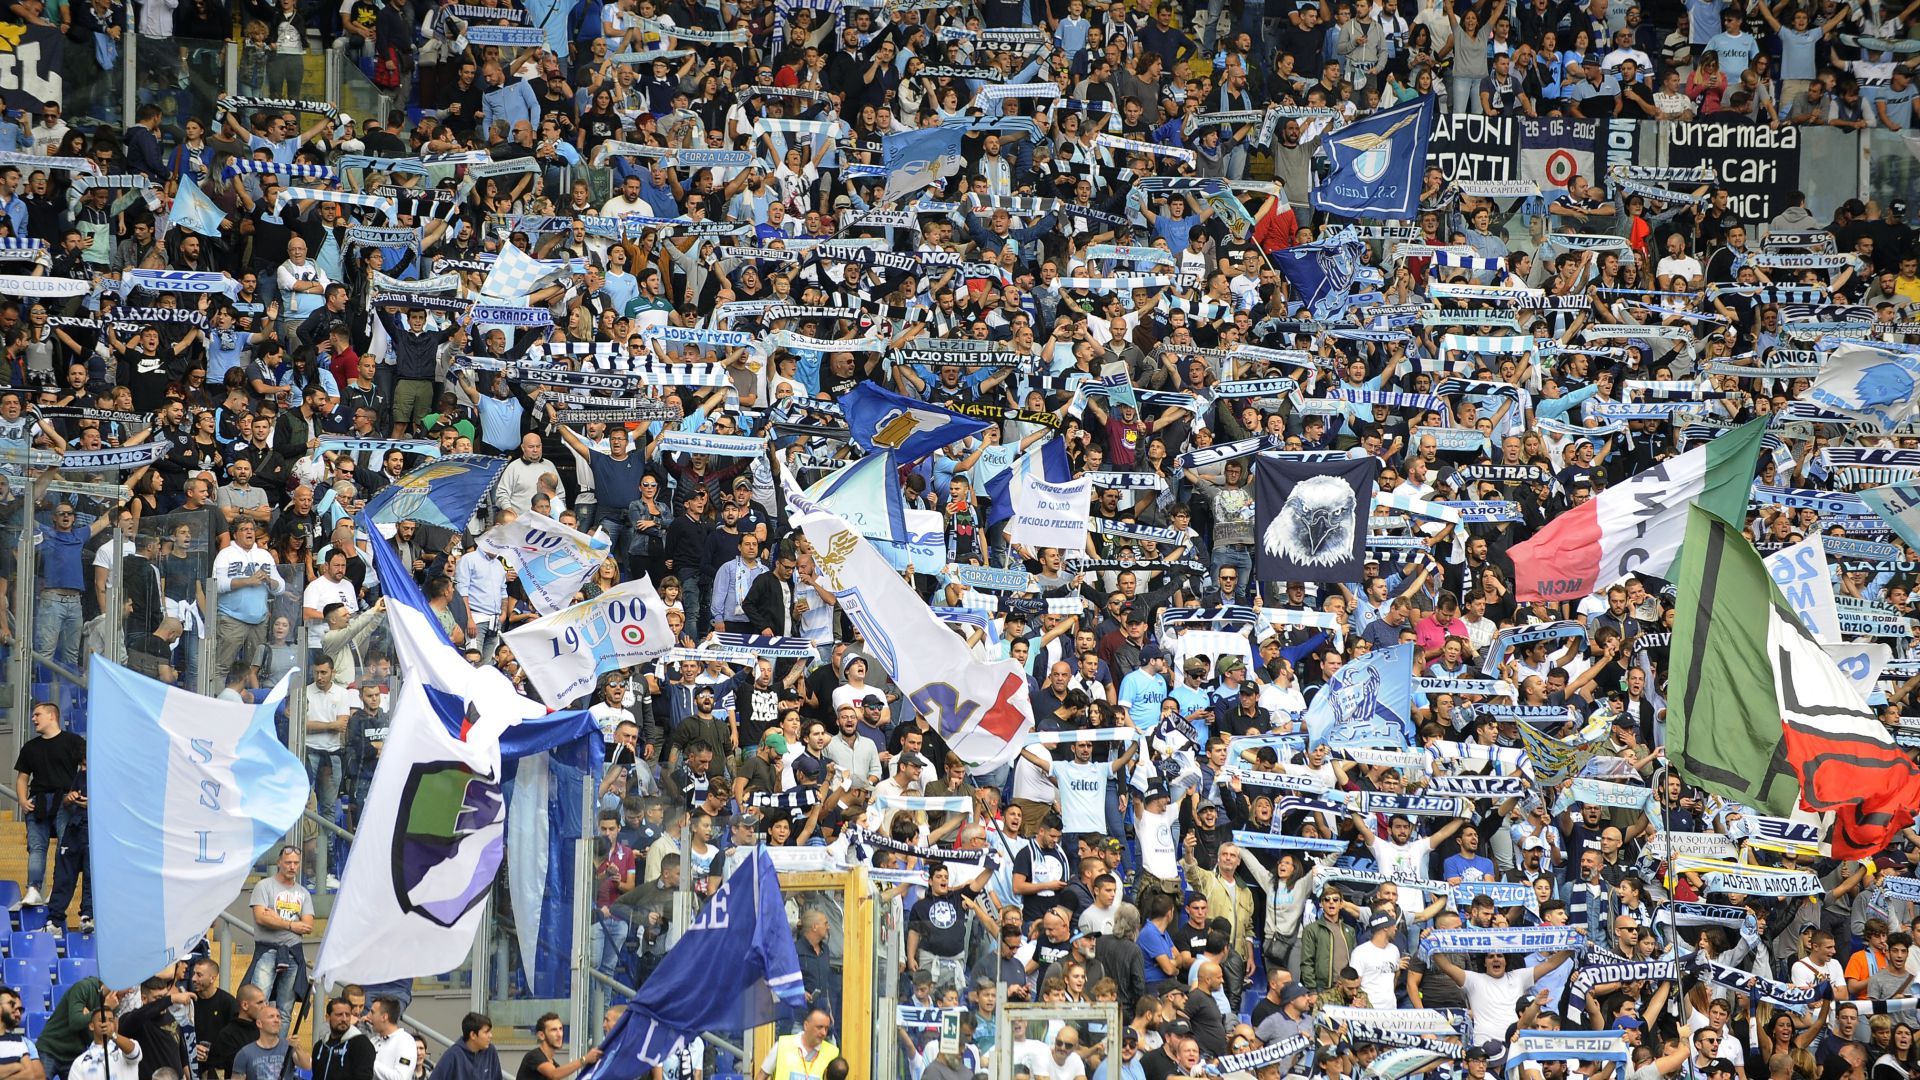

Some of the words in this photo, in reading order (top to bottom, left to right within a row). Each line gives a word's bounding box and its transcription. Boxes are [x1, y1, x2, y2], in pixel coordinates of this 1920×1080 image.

[1525, 121, 1540, 137] 26
[1550, 119, 1564, 136] 05
[1573, 121, 1596, 140] 2013
[685, 151, 715, 162] FORZA
[717, 152, 745, 162] LAZIO
[1326, 225, 1374, 239] UNCA
[1380, 226, 1418, 239] FEDE
[1781, 257, 1813, 267] LAZIO
[1818, 256, 1848, 267] 1900
[22, 280, 55, 292] CLUB
[58, 282, 84, 292] NYC
[143, 279, 211, 292] LAZIO
[1479, 288, 1529, 299] LAZIO
[492, 309, 534, 322] GRANDE
[1438, 308, 1480, 319] AVANTI
[1484, 309, 1515, 320] LAZIO
[928, 339, 977, 351] LAZIO
[903, 350, 943, 362] LAZIO
[943, 351, 978, 363] STILE
[979, 352, 993, 363] DI
[995, 353, 1021, 363] VITA
[1769, 350, 1819, 364] UNICA
[527, 371, 571, 383] EST.
[581, 375, 624, 388] 1900
[1220, 384, 1258, 394] FORZA
[1259, 381, 1293, 392] LAZIO
[83, 407, 112, 418] MOLTO
[113, 411, 143, 421] ONORE
[566, 410, 637, 422] IRRIDUCIBILI
[642, 410, 677, 421] LAZIO
[1018, 409, 1063, 429] LAZIO
[344, 440, 415, 451] LAZIO
[705, 439, 758, 452] Romanisti
[60, 455, 104, 468] FORZA
[104, 452, 144, 466] LAZIO
[797, 453, 848, 469] LAZIO
[1470, 464, 1542, 480] ULTRAS
[1771, 495, 1844, 512] LAZIO
[1103, 518, 1129, 531] S.S.
[1136, 523, 1178, 540] LAZIO
[1822, 537, 1857, 551] FORZA
[1858, 542, 1893, 556] LAZIO
[1843, 561, 1915, 572] LAZIO
[965, 569, 994, 582] FORZA
[995, 573, 1022, 585] LAZIO
[1876, 623, 1906, 635] 1900
[1511, 629, 1558, 644] LAZIO
[1633, 632, 1672, 652] CURV
[1482, 704, 1523, 716] FORZA
[1523, 705, 1562, 716] LAZIO
[1261, 773, 1313, 787] LAZIO
[1370, 796, 1400, 808] S.S.
[1406, 798, 1454, 811] LAZIO
[1596, 792, 1637, 806] 1900
[1679, 843, 1727, 855] CAPITALE
[1886, 880, 1920, 892] FORZ
[1450, 931, 1493, 946] Forza
[1520, 932, 1555, 947] lazio
[1565, 1038, 1613, 1051] LAZIO
